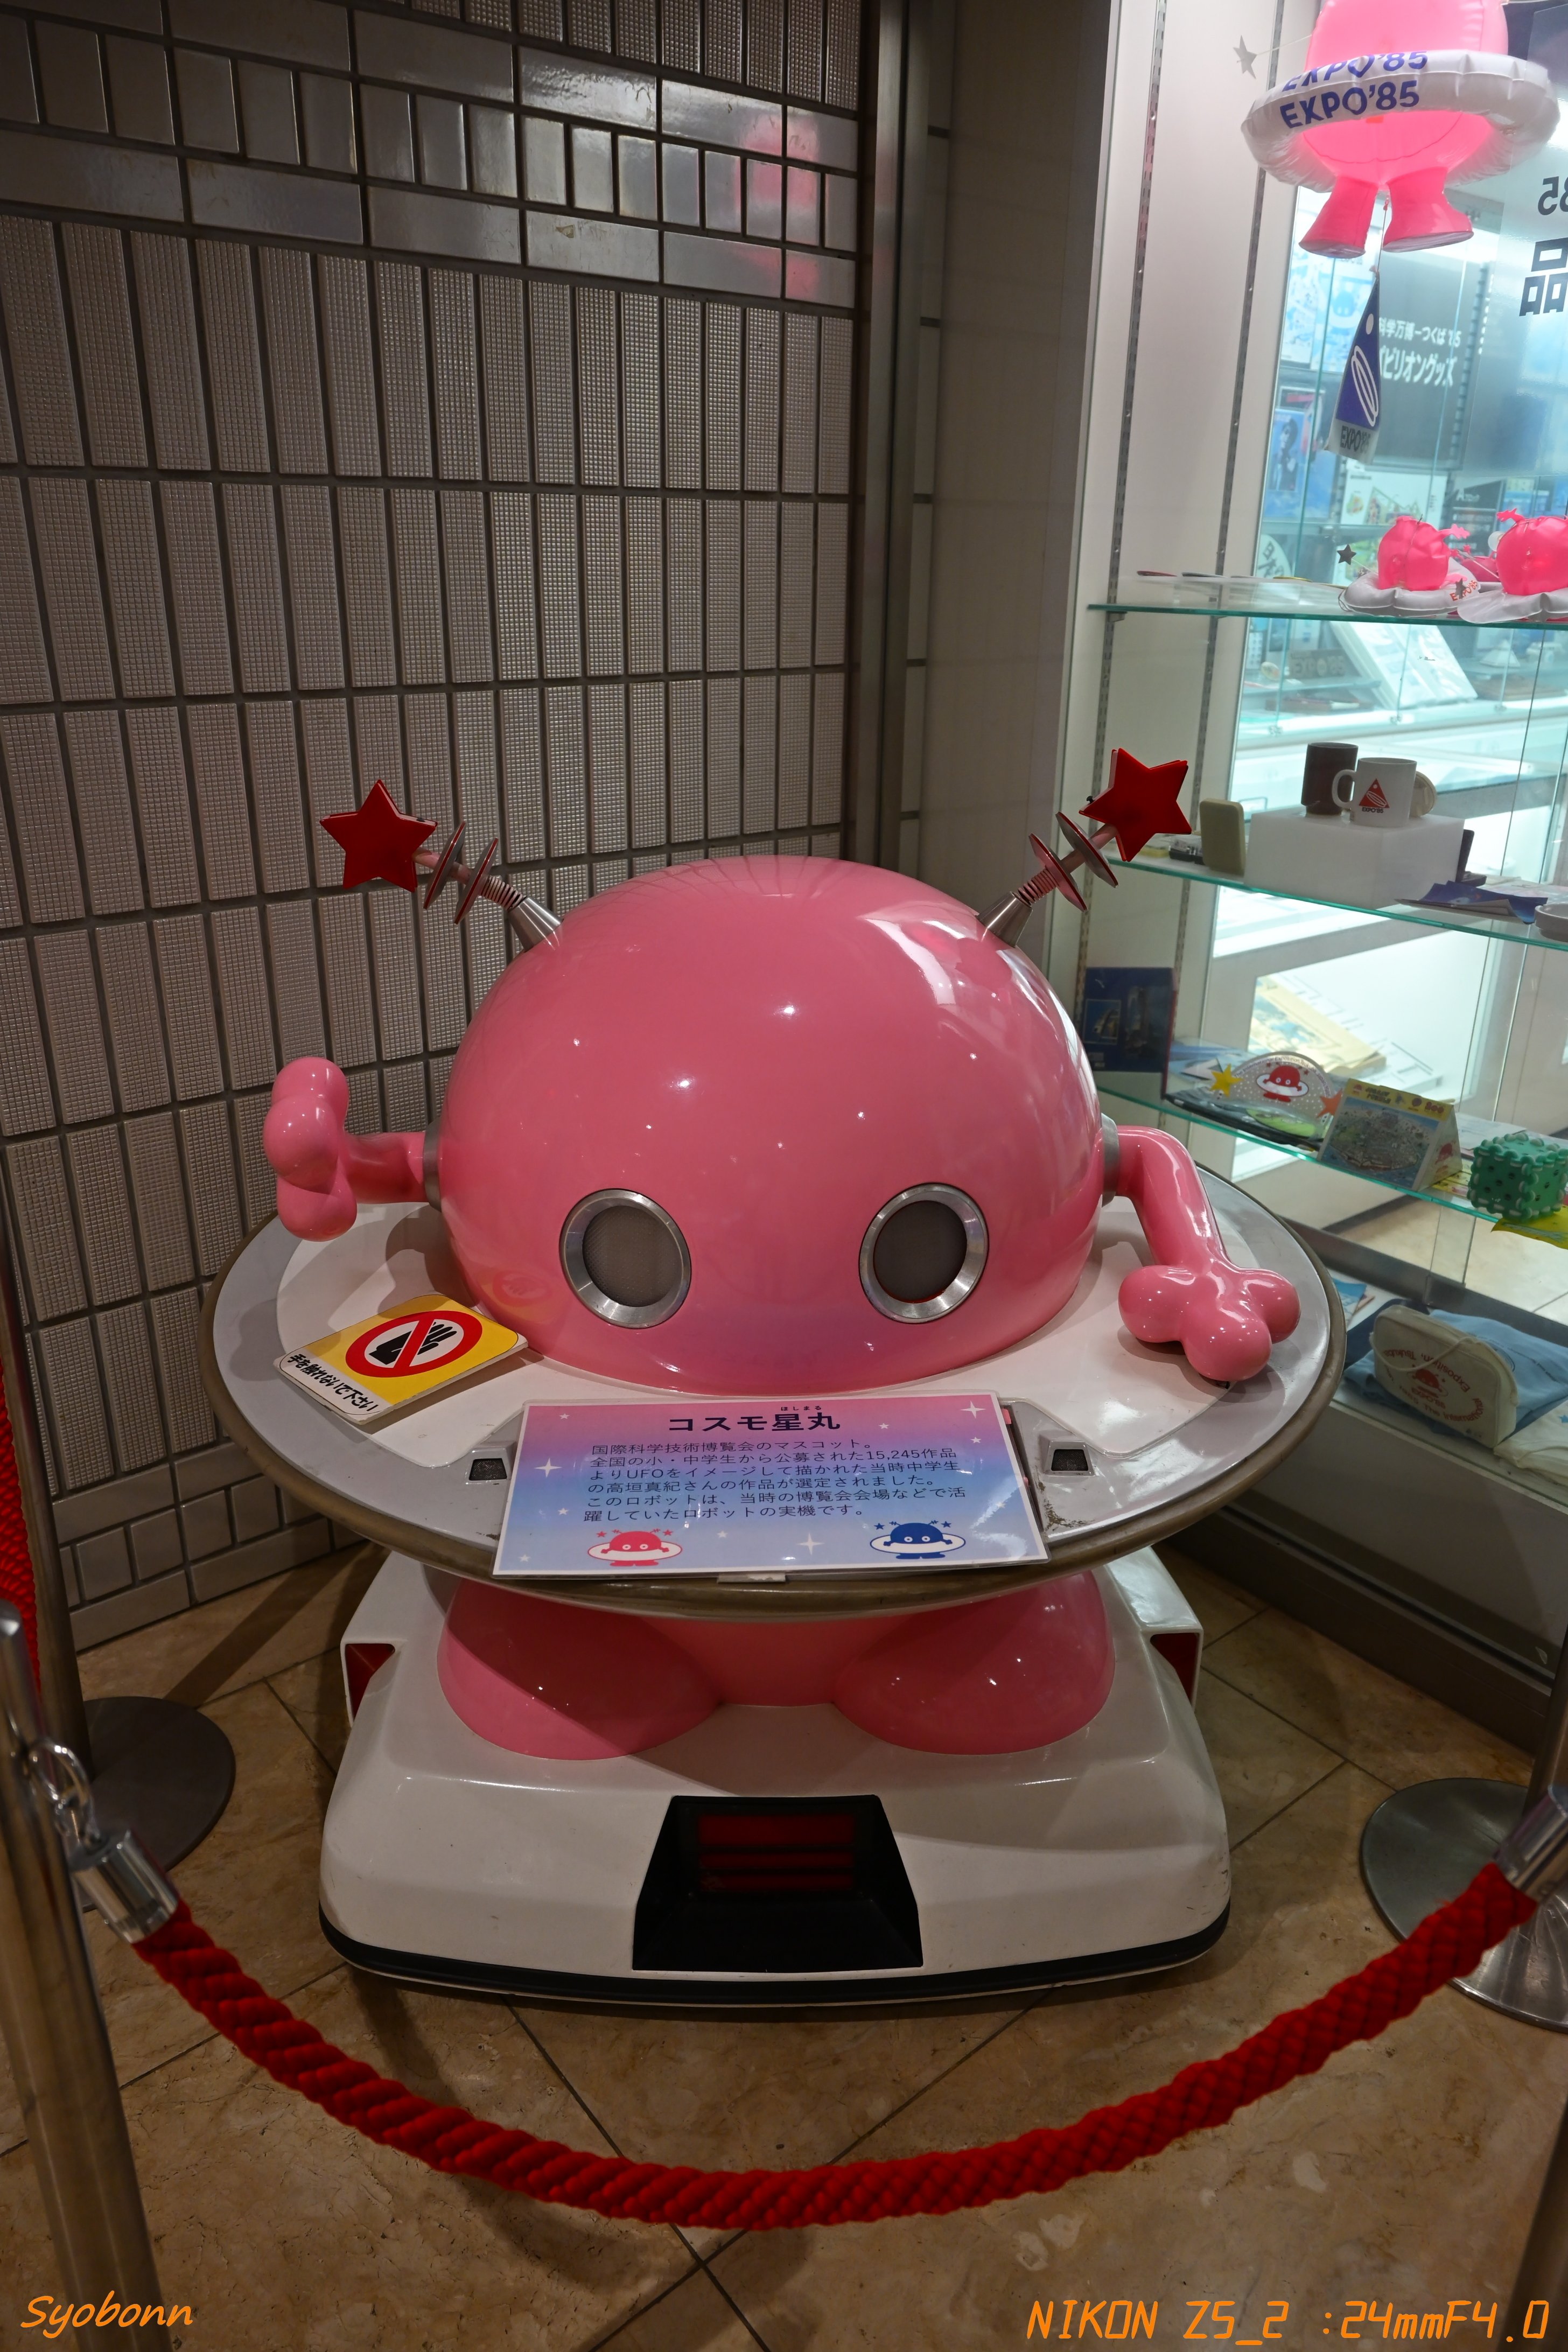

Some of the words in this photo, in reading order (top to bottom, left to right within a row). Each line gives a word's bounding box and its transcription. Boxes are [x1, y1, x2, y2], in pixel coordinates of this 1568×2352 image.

[1280, 80, 1419, 128] EXPO'85
[1450, 580, 1478, 601] EPO'85
[287, 1354, 379, 1411] 手を触れないで下さい
[669, 1412, 841, 1432] コスモ星丸
[592, 1439, 871, 1455] 国際科学技術博覧会のマスコット。
[590, 1448, 957, 1468] 全国の小・中学生から公募された15,245作品
[590, 1461, 961, 1480] よりUFOをイメージして描かれた当時中学生
[588, 1475, 934, 1494] の高垣真紀さんの作品が選定されました。
[588, 1487, 965, 1507] このロボットは、当時の博覧会会場などで活
[584, 1505, 862, 1522] 躍していたロボットの実機です。
